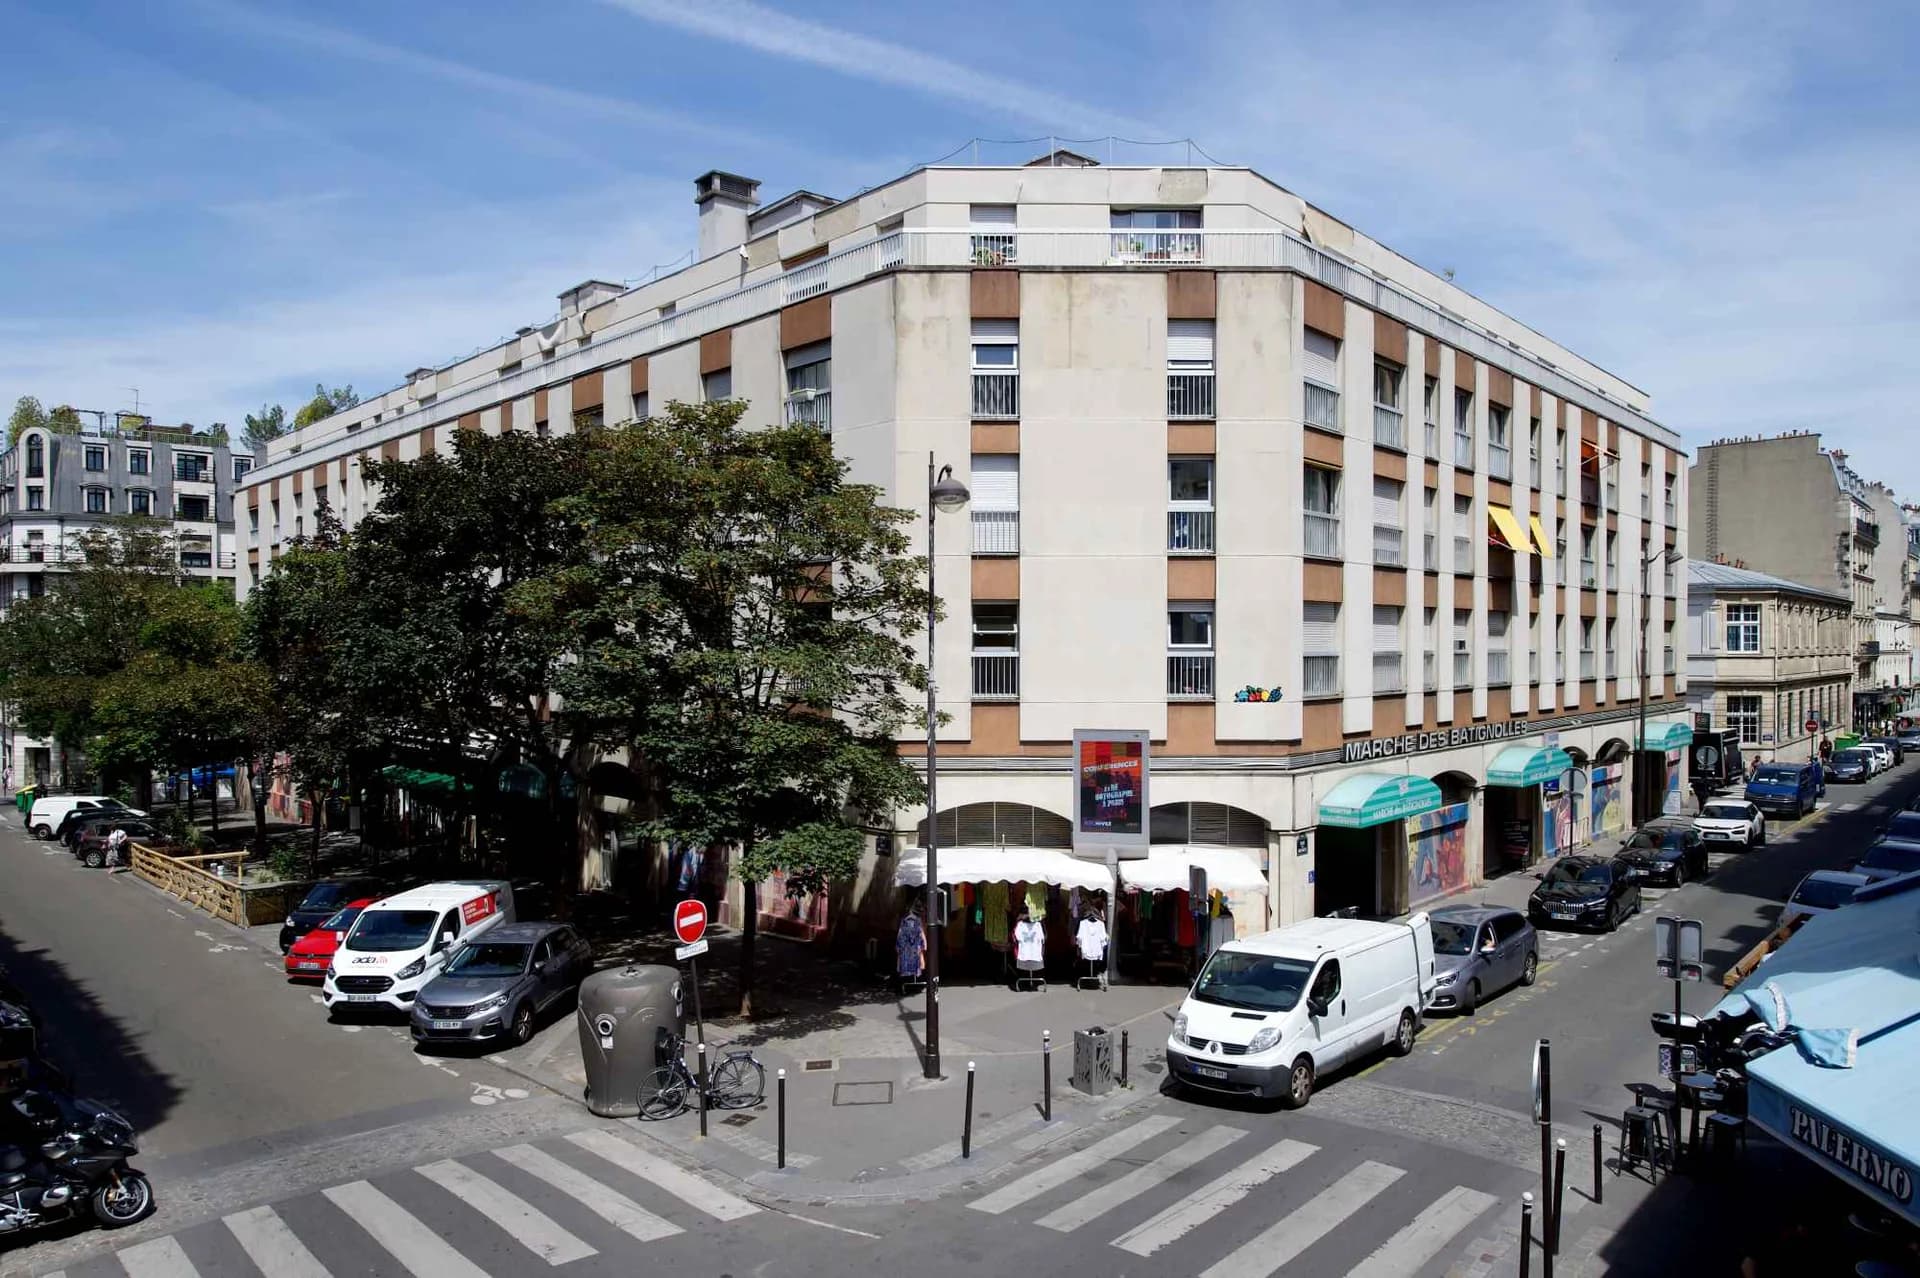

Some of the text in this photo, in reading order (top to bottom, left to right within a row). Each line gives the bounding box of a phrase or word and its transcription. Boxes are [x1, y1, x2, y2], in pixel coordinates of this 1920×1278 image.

[1345, 719, 1528, 762] MARCHE DES BATIGNOLLES
[1791, 1107, 1912, 1200] PALERMO
